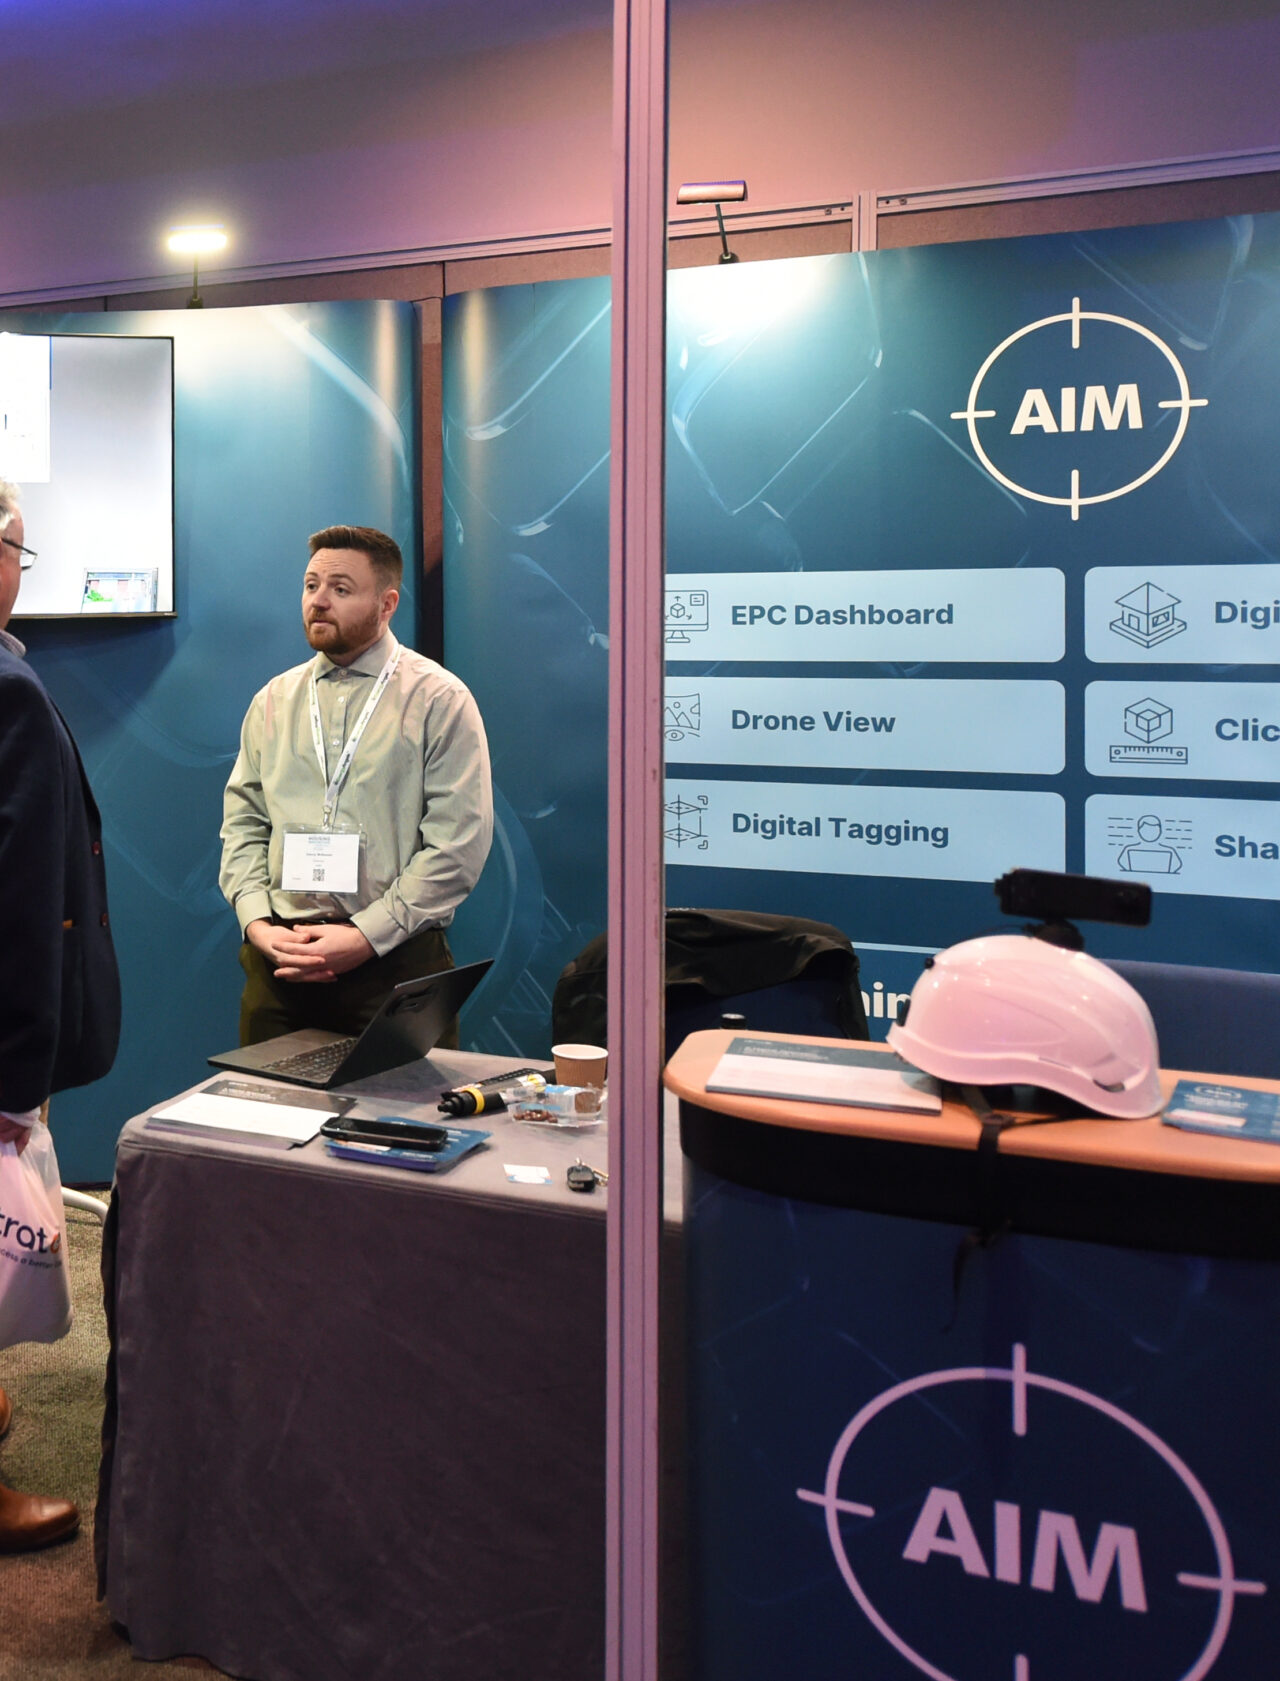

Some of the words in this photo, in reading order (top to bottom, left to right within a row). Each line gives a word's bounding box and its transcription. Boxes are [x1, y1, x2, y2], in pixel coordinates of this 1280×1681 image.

[1010, 383, 1143, 435] AIM
[732, 605, 787, 625] EPC
[795, 604, 954, 625] Dashboard
[1215, 600, 1280, 630] Digi
[732, 709, 816, 731] Drone
[823, 710, 896, 733] View
[1215, 718, 1280, 742] Clic
[732, 812, 821, 840] Digital
[828, 817, 949, 849] Tagging
[1215, 834, 1280, 860] Sha
[902, 1486, 1148, 1613] AIM
